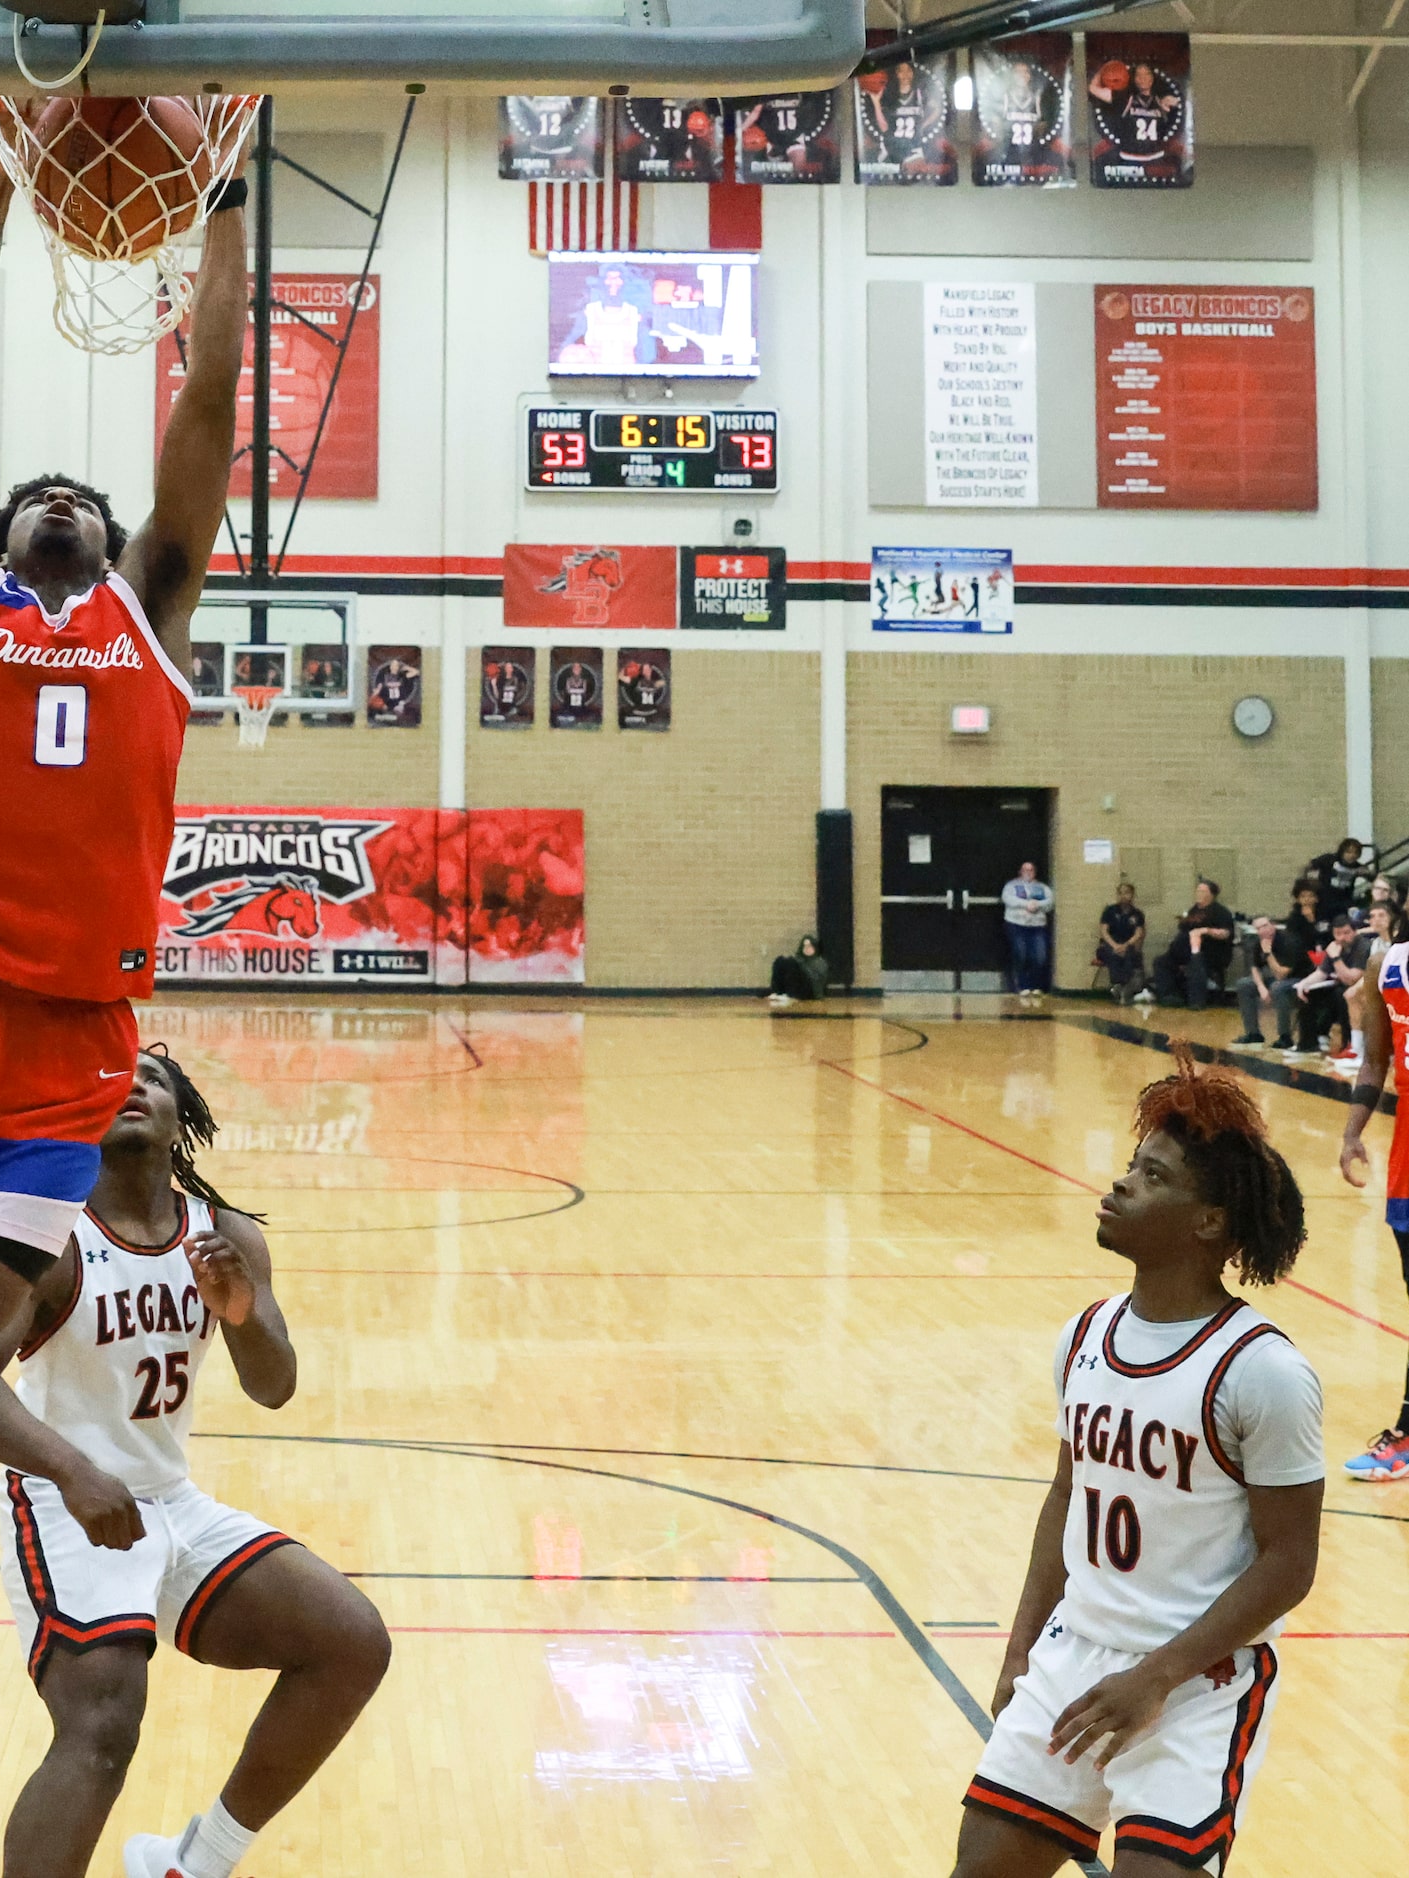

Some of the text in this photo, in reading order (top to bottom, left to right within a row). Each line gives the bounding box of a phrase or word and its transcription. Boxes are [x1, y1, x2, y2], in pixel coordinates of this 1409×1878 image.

[540, 113, 562, 135] 12
[663, 108, 682, 129] 13
[777, 110, 797, 131] 15
[894, 117, 915, 138] 22
[1012, 122, 1033, 145] 23
[1136, 118, 1158, 141] 24
[1132, 294, 1281, 318] LEGACY BRONCOS
[1135, 322, 1275, 337] BOYS BASKETBALL
[537, 412, 581, 429] HOME
[716, 415, 774, 431] VISITOR
[543, 433, 585, 466] 53
[730, 435, 773, 468] 73
[553, 472, 591, 485] BONUS
[621, 464, 662, 477] PERIOD
[666, 460, 685, 486] 4
[714, 474, 752, 487] BONUS
[694, 578, 769, 598] PROTECT
[695, 598, 723, 614] THIS
[34, 683, 88, 767] 0
[216, 823, 310, 832] LEGACY
[163, 826, 361, 884] BRONCOS
[194, 948, 237, 972] THIS
[129, 1351, 189, 1420] 25
[1084, 1486, 1141, 1573] 10
